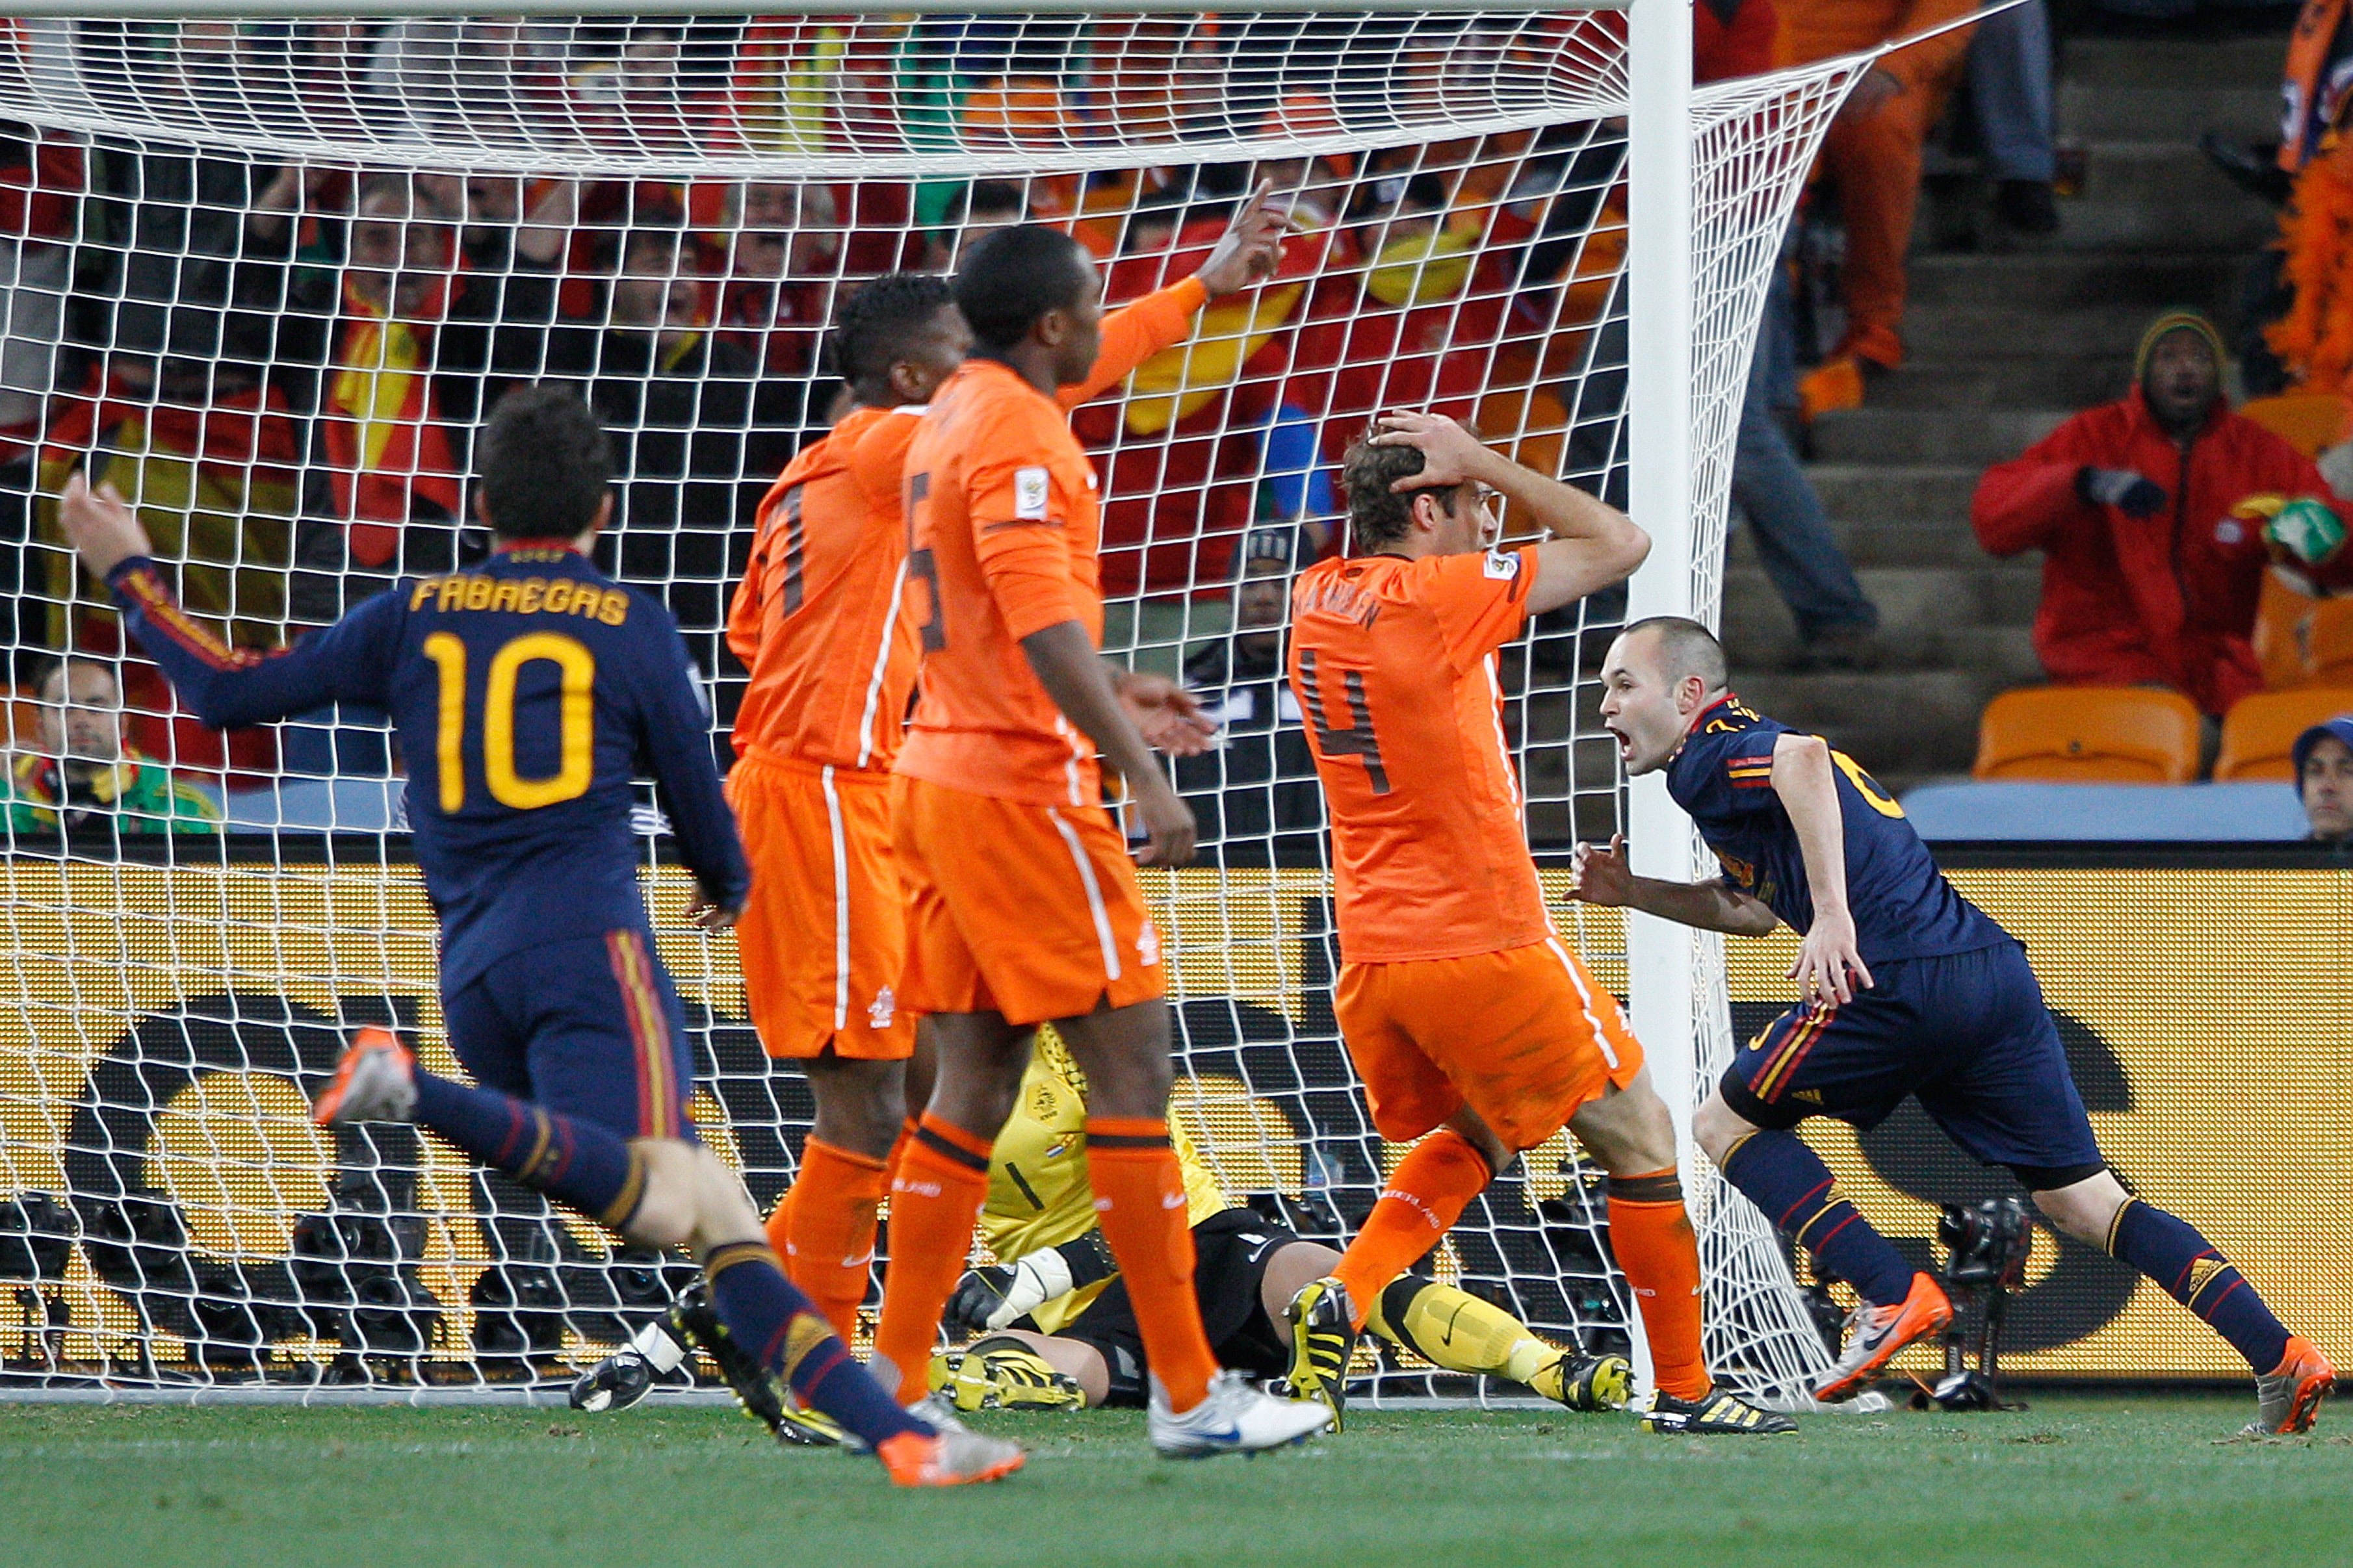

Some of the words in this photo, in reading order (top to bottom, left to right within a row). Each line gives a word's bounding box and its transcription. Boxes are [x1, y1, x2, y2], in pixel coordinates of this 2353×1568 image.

[410, 574, 630, 626] FABREGAS
[423, 630, 595, 813] 10
[1299, 650, 1390, 794] 4
